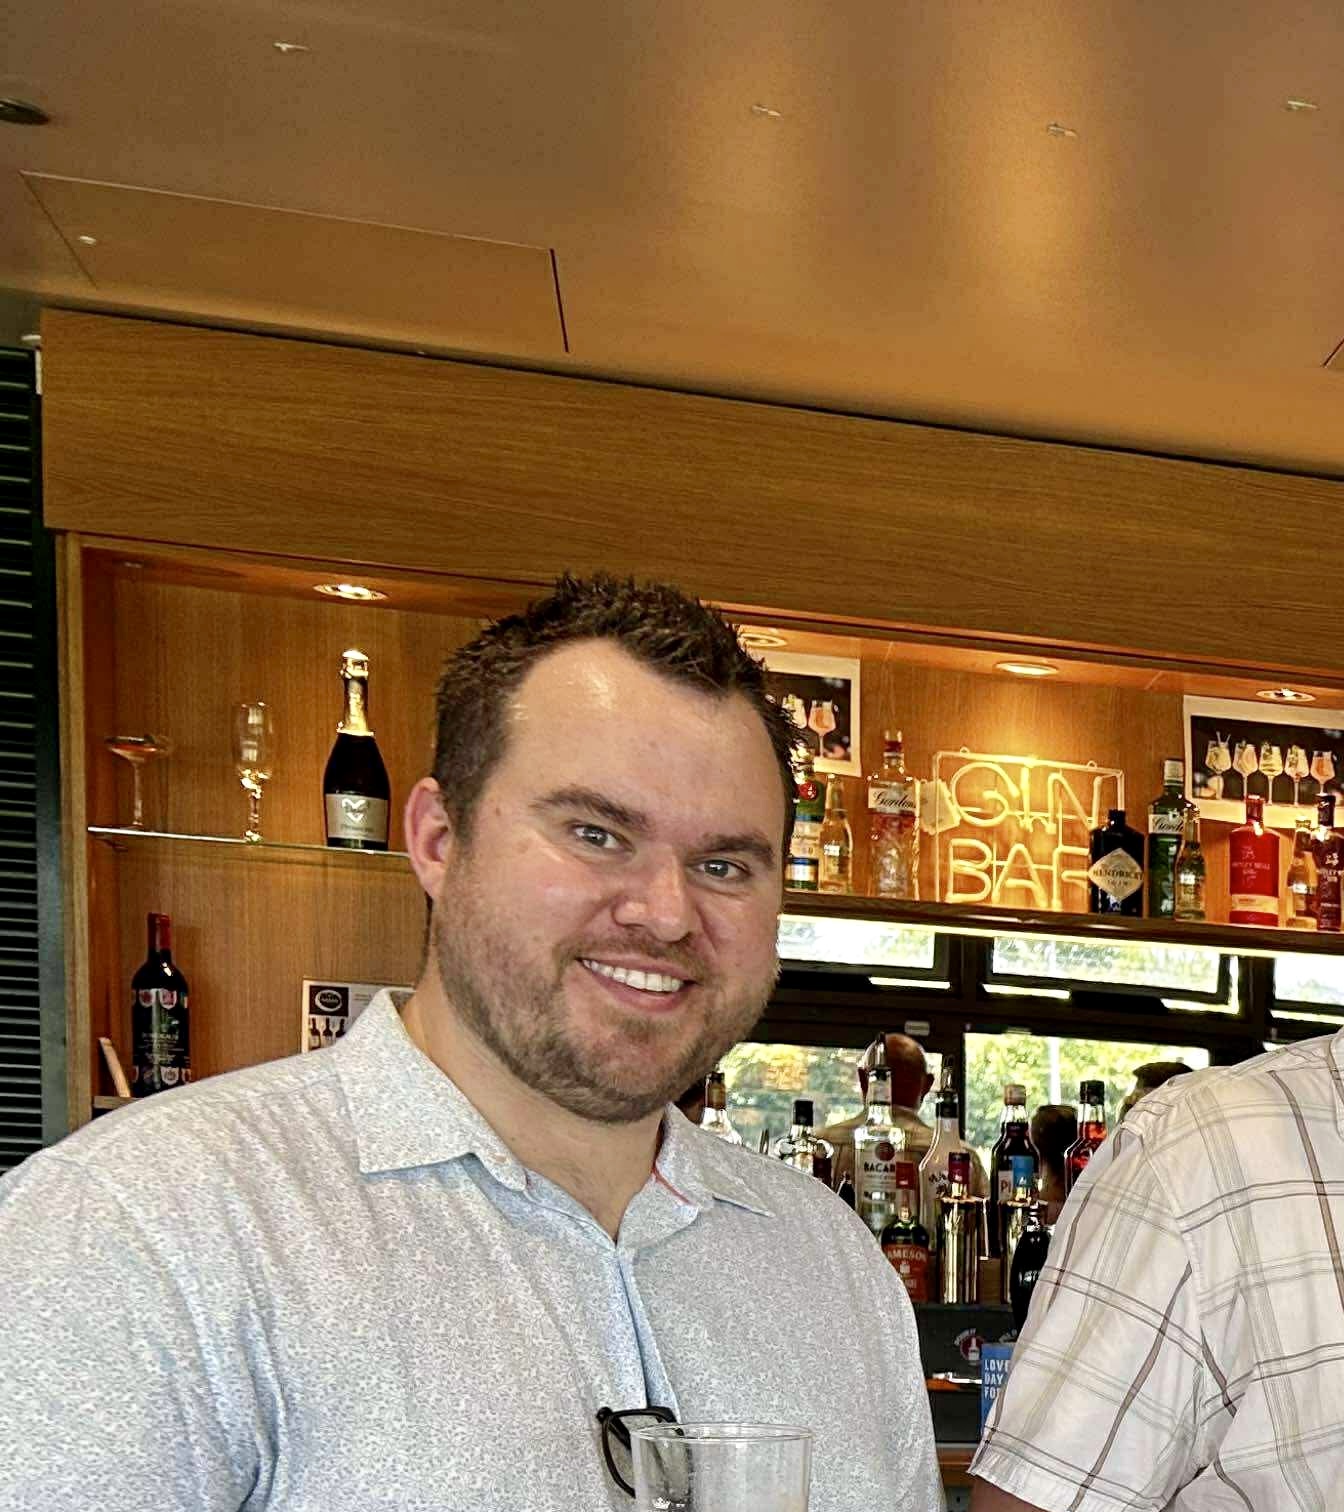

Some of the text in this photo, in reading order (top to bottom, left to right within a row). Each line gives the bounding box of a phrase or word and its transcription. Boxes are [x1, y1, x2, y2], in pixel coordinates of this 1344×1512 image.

[873, 791, 916, 808] Gordon
[951, 762, 1102, 834] GIN
[864, 1161, 896, 1173] BACAR
[887, 1247, 927, 1263] AMESON
[984, 1373, 1004, 1385] DAY
